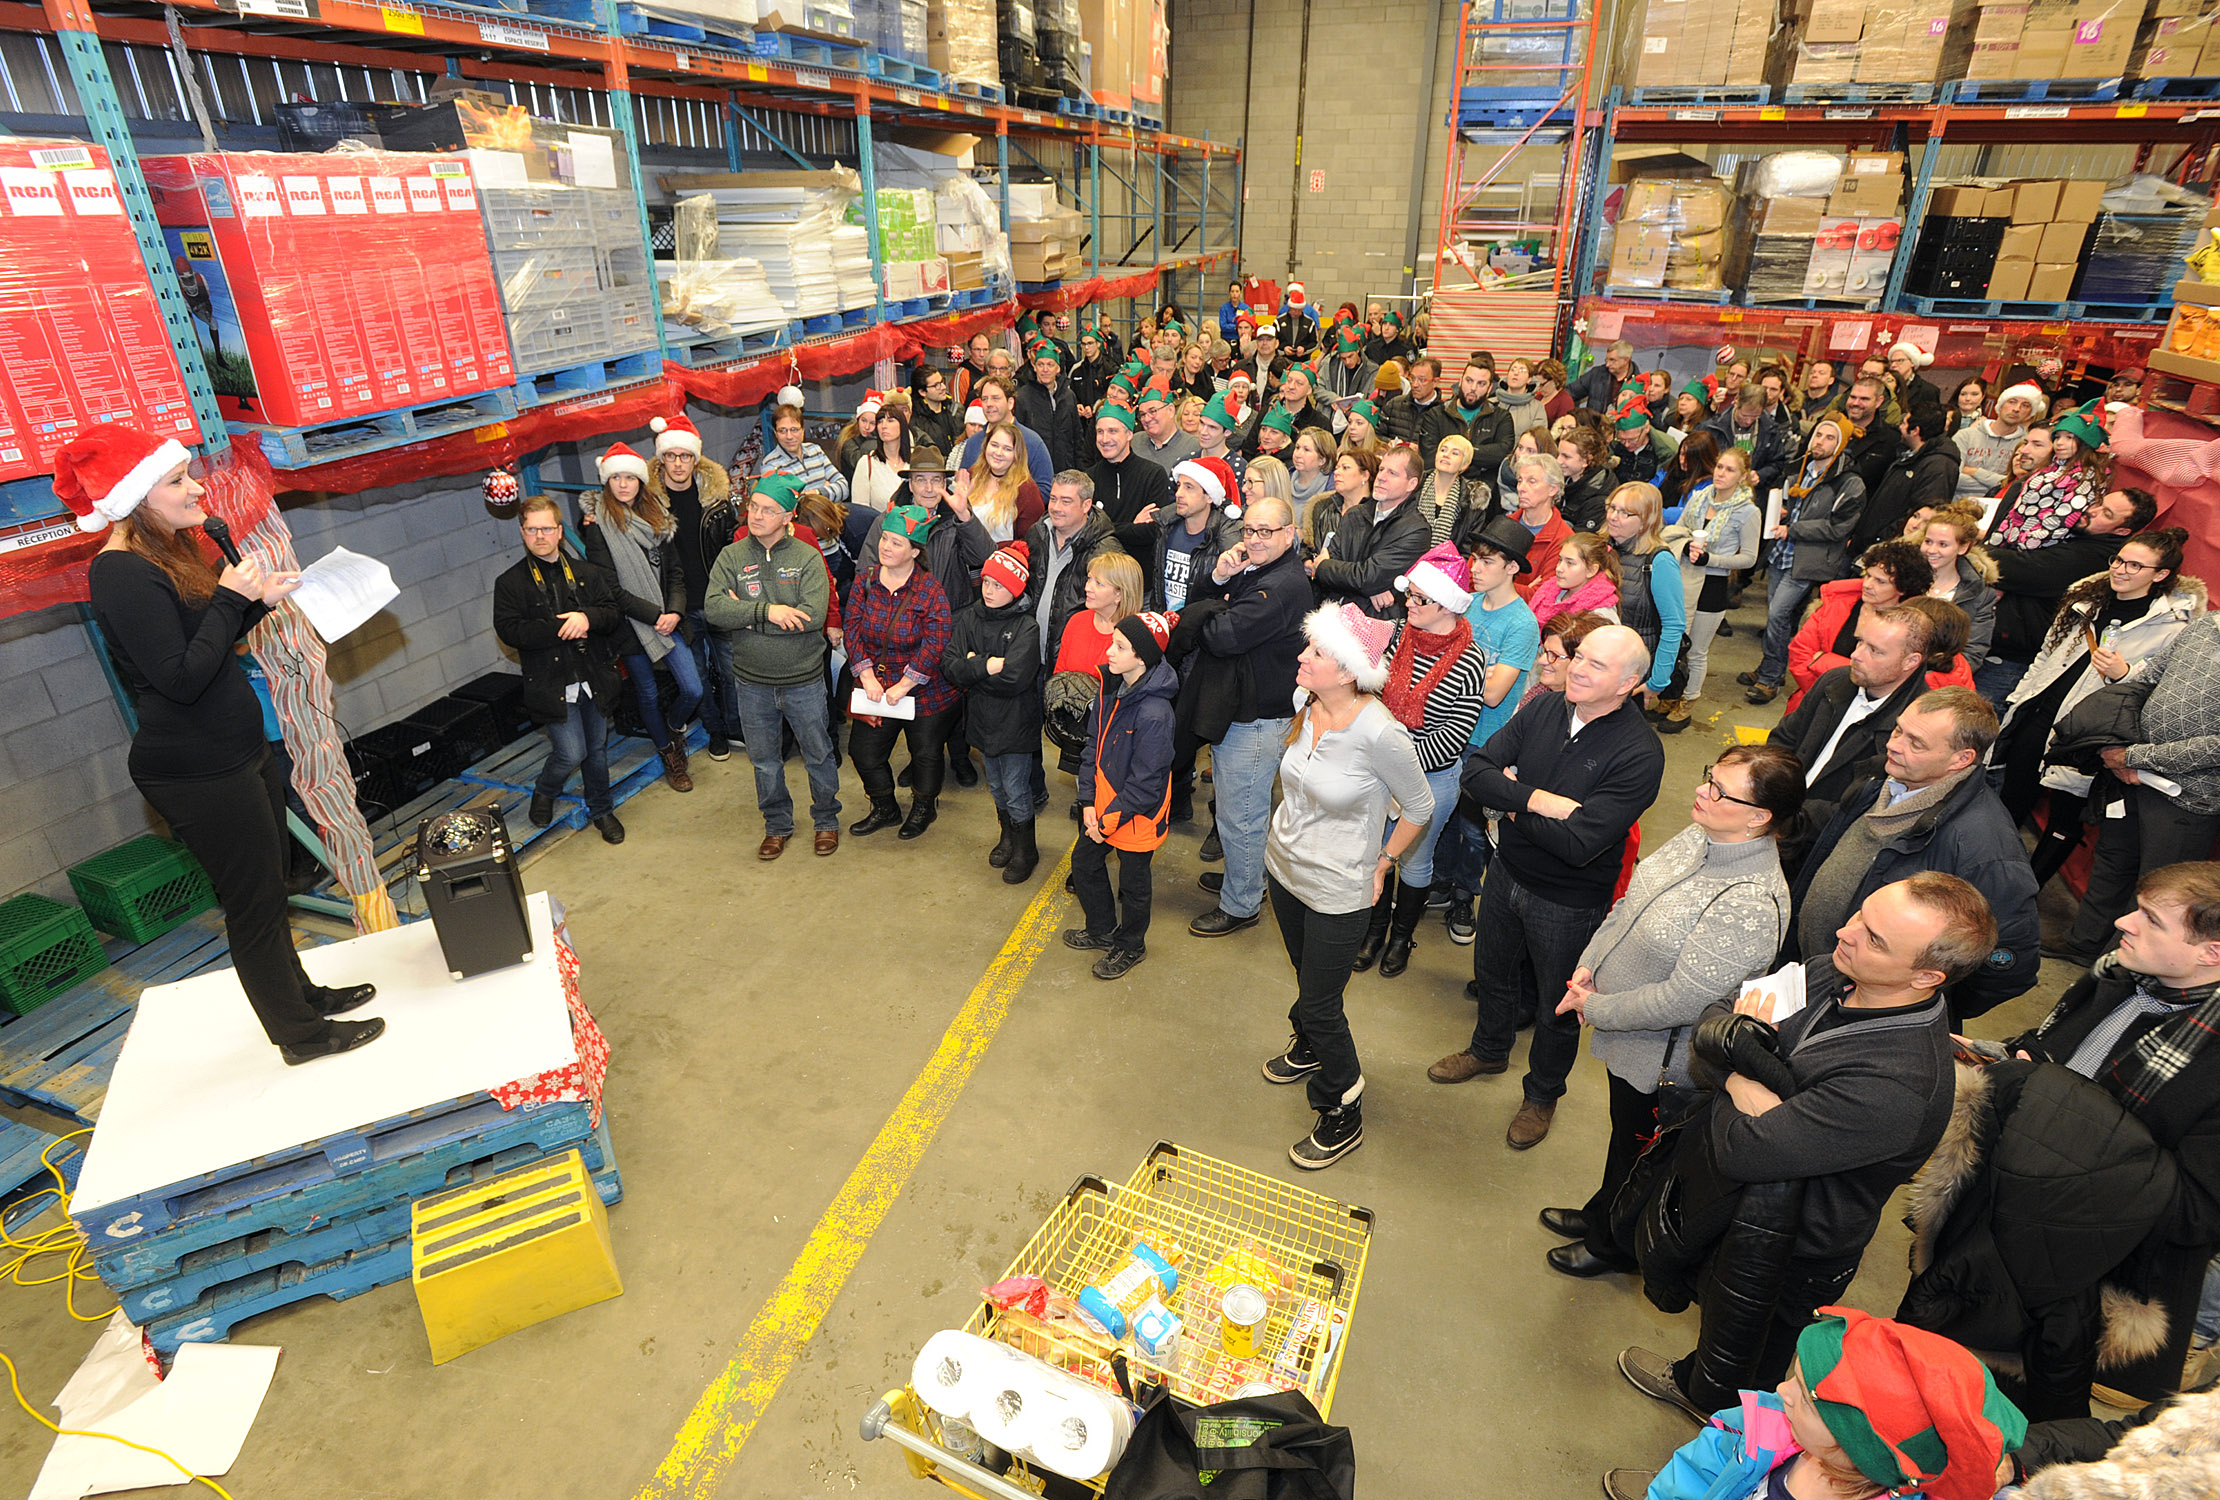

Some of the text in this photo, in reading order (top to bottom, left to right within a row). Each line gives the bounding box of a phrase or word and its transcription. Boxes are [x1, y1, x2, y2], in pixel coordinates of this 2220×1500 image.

[1931, 21, 1944, 32] 16
[2079, 23, 2101, 40] 16
[504, 36, 523, 45] ESPACE
[8, 186, 54, 198] RCA
[72, 186, 113, 198] RCA
[289, 190, 320, 201] RCA
[333, 190, 362, 201] RCA
[375, 190, 402, 200] RCA
[412, 190, 437, 199] RCA
[449, 188, 472, 198] RCA
[17, 526, 72, 547] RÉCEPTION
